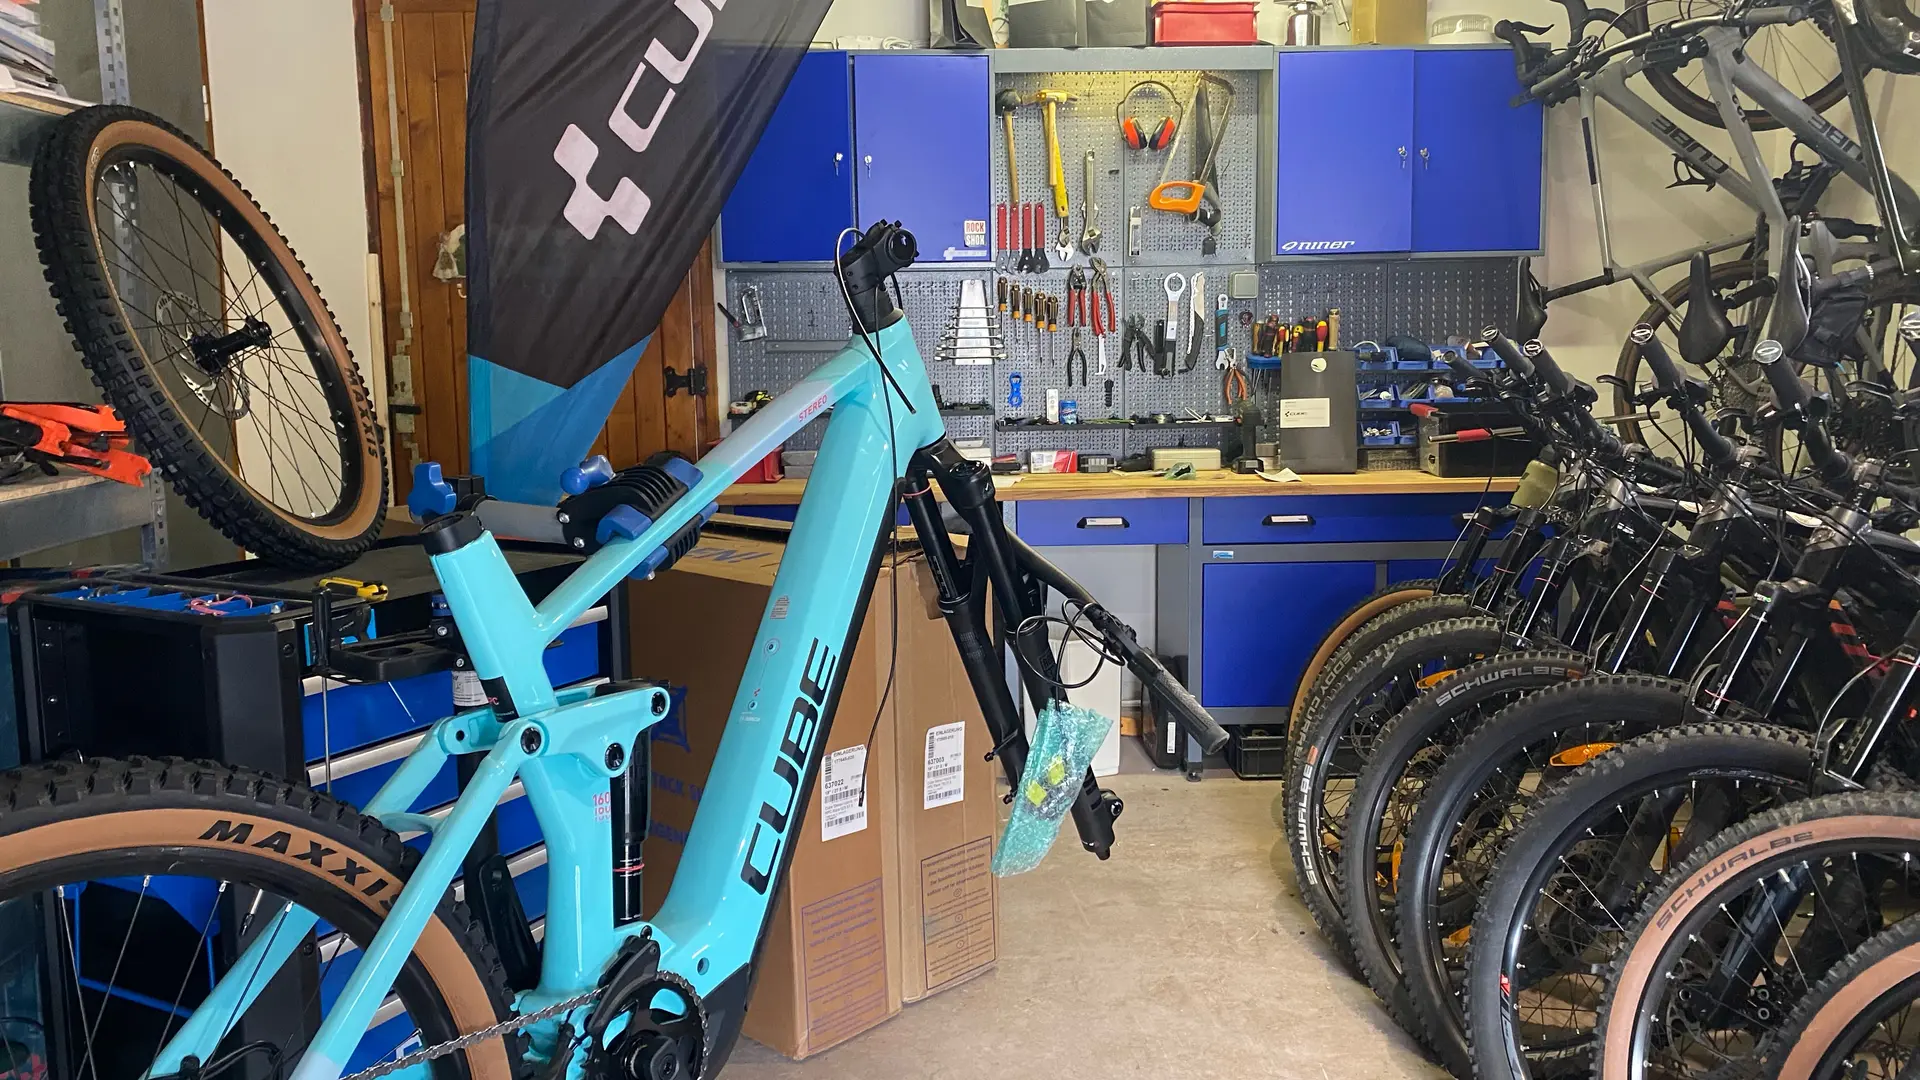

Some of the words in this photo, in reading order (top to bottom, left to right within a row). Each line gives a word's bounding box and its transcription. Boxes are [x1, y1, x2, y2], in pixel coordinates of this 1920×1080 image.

[608, 0, 727, 152] CU
[1808, 116, 1867, 165] UBE
[966, 222, 985, 233] ROCK
[344, 367, 379, 459] MAXXIS
[798, 394, 829, 422] STEREO
[1320, 651, 1353, 694] EDDY
[1435, 665, 1566, 707] SCHWALBE
[740, 636, 836, 895] CUBE
[824, 778, 844, 789] 637022
[1298, 763, 1319, 886] SCHWALBE
[1656, 831, 1814, 932] SCHWALBE
